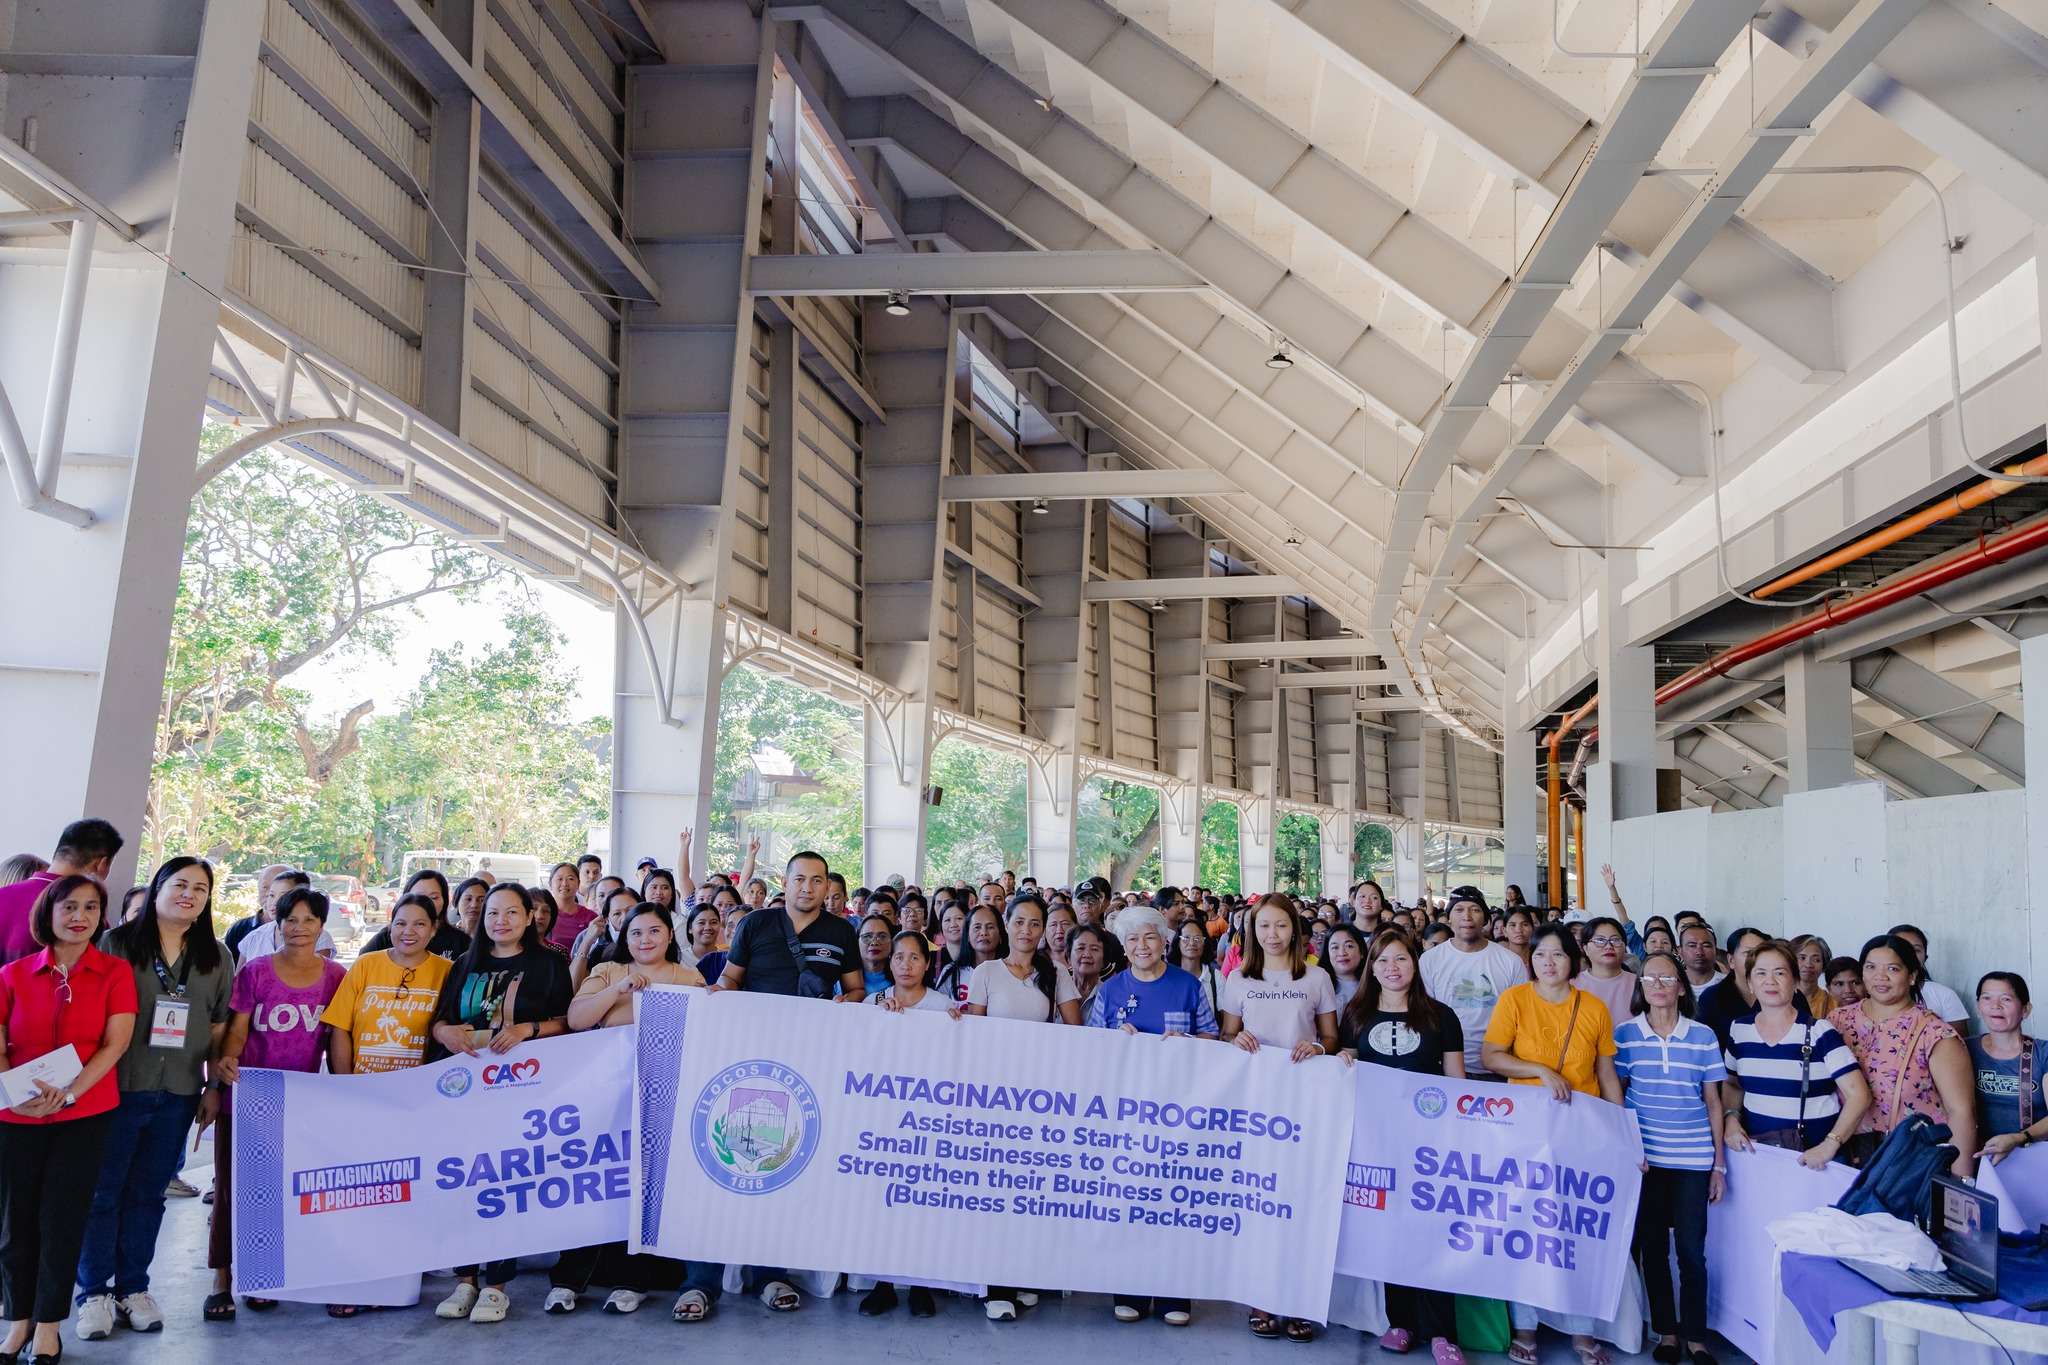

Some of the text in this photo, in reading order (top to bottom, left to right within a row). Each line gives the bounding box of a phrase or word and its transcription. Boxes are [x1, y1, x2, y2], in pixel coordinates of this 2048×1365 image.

[361, 993, 436, 1018] Pagudpud
[1246, 990, 1308, 1000] Calvin Klein
[254, 1003, 331, 1033] LOV
[408, 1035, 428, 1045] 195
[1527, 1045, 1560, 1057] Calvin
[698, 1065, 816, 1120] ILOCOS NORTE
[1980, 1071, 1995, 1080] Lee
[522, 1104, 581, 1141] 3G
[844, 1071, 1302, 1143] MATAGINAYON A PROGRESO:
[899, 1110, 1242, 1160] Assistance to Start-Ups and
[299, 1159, 415, 1194] MATAGINAYON
[730, 1176, 764, 1190] 1818
[858, 1131, 1278, 1192] Small Businesses to Continue and
[1413, 1146, 1616, 1205] SALADINO
[310, 1183, 403, 1213] A PROGRESO
[476, 1166, 631, 1219] STORE
[836, 1153, 1292, 1220] Strengthen their Business Operation
[885, 1182, 1241, 1237] (Business Stimulus Package)
[1410, 1181, 1611, 1241] SARI- SARI
[1448, 1220, 1576, 1271] STORE
